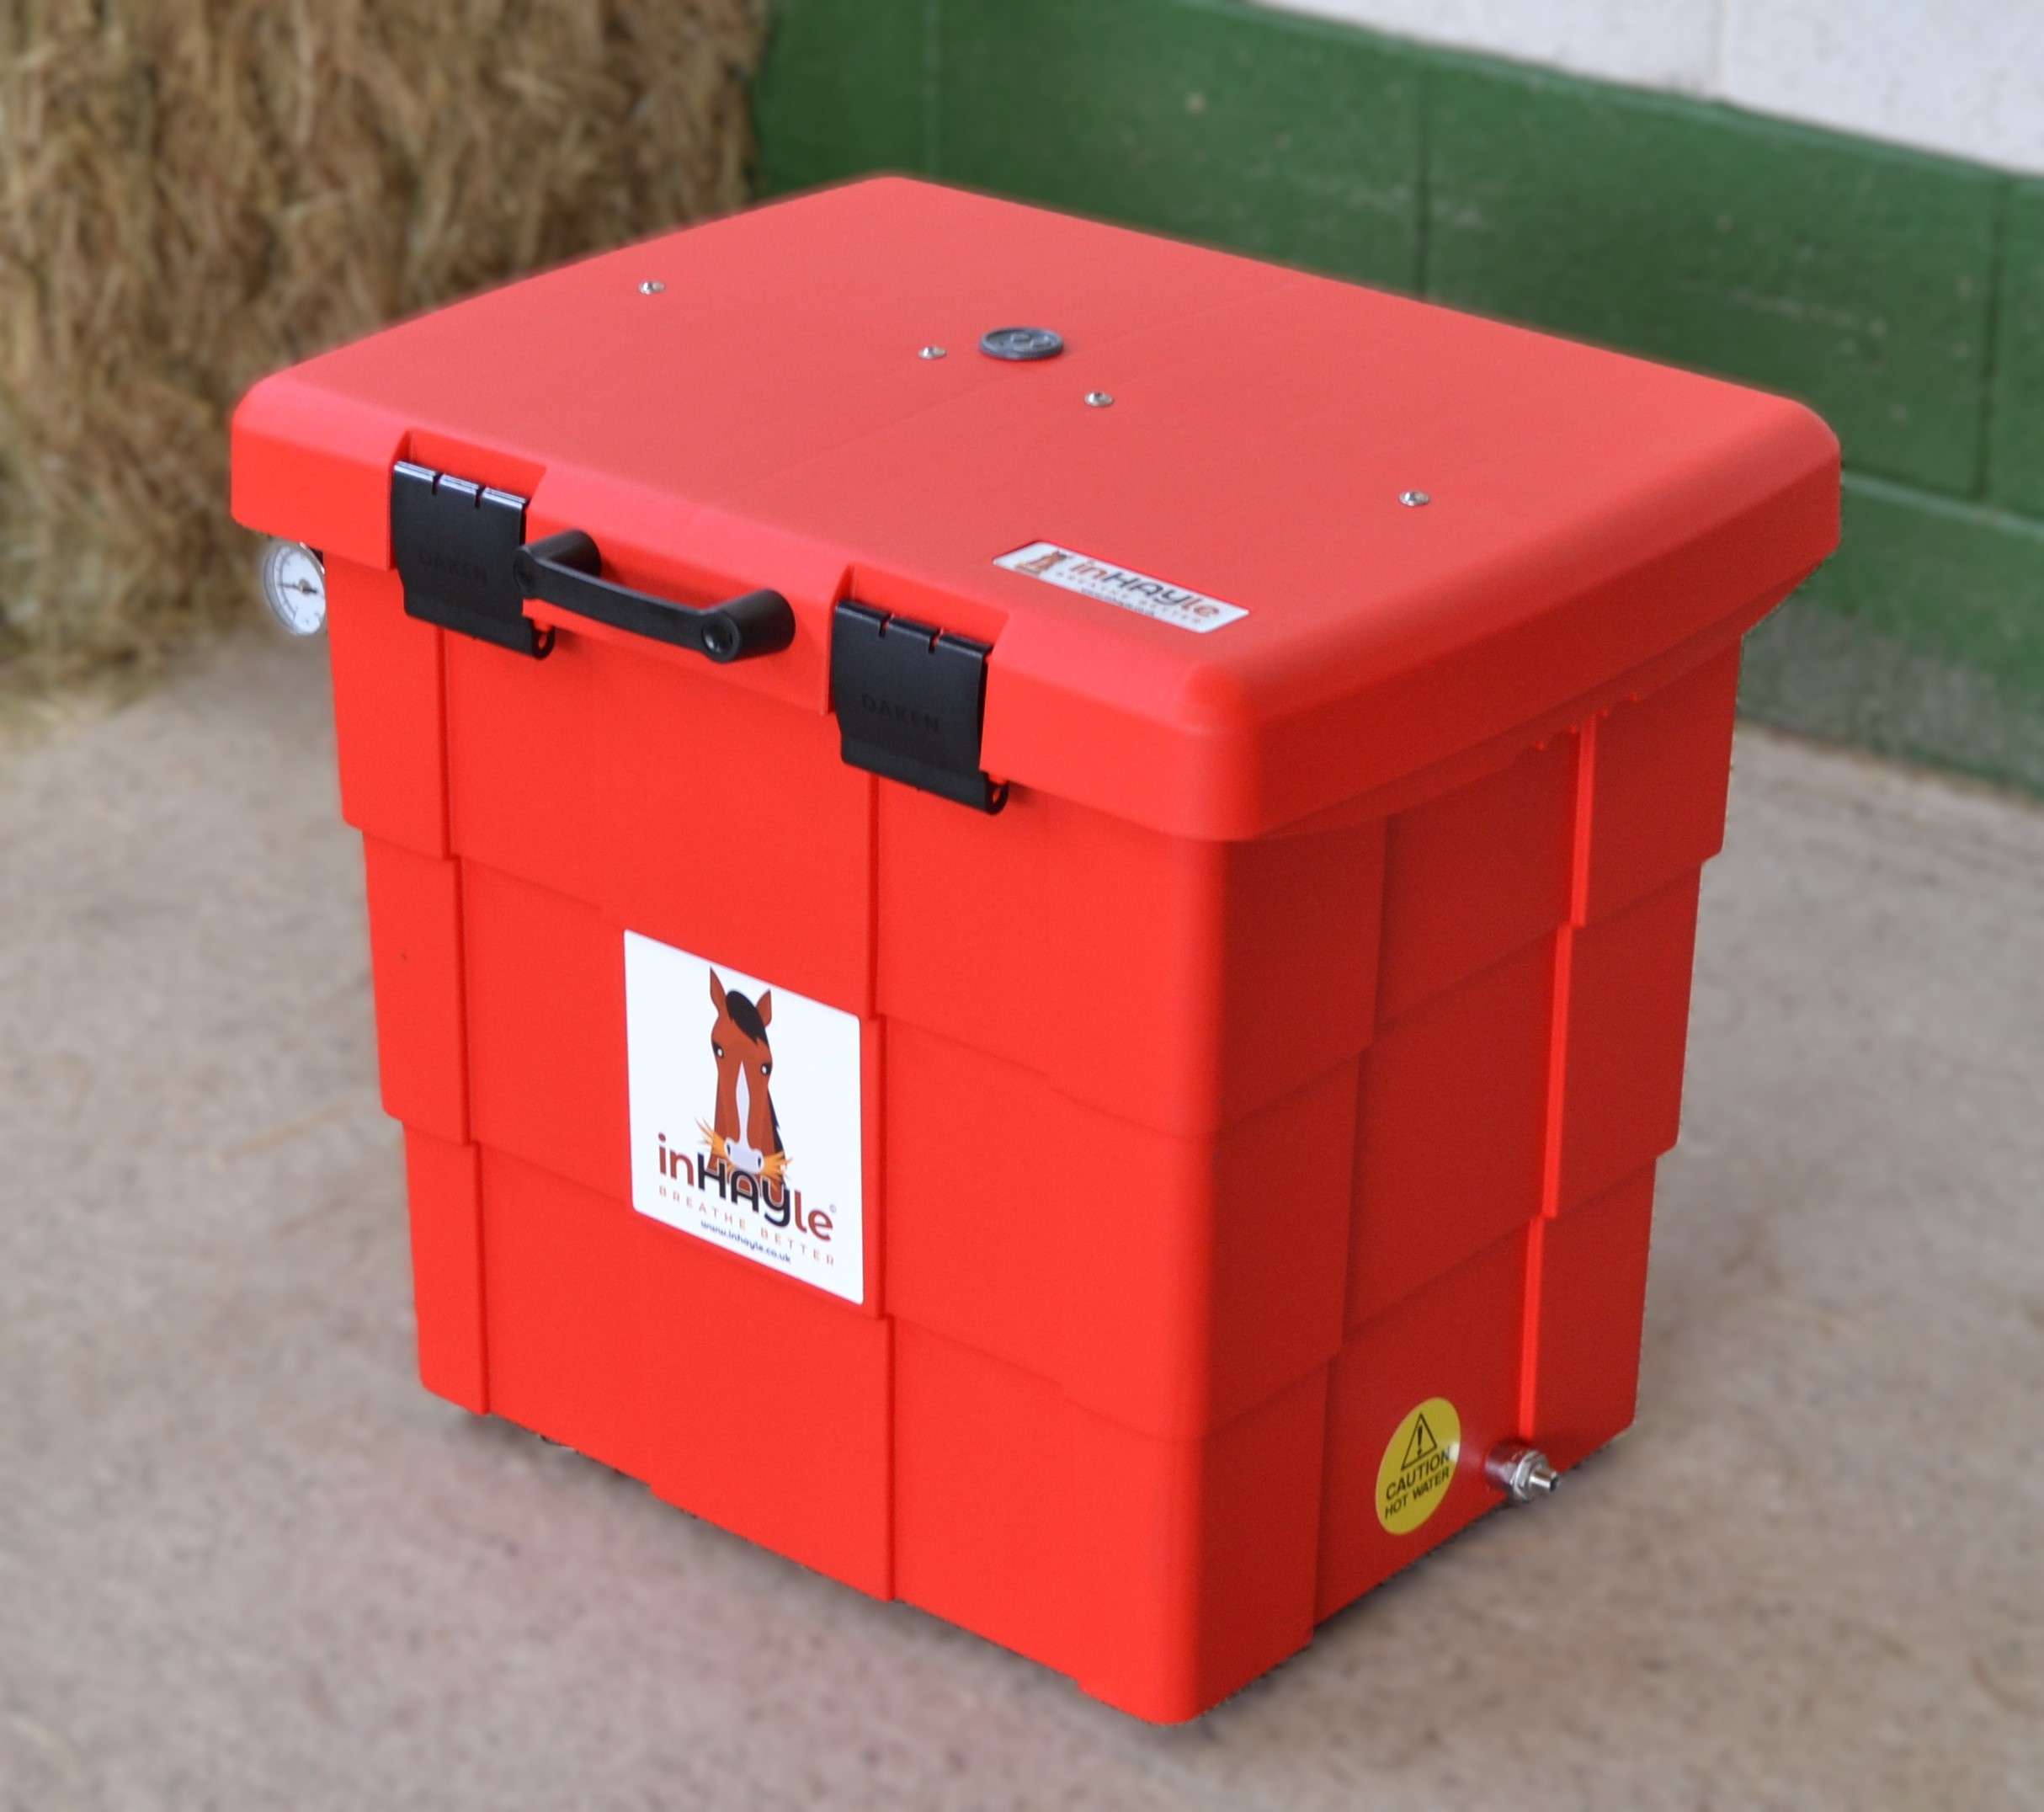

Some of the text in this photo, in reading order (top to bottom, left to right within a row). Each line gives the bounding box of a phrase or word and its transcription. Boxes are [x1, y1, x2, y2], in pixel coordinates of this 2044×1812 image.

[659, 1185, 834, 1266] BREATHE BETTER
[700, 1219, 791, 1263] www.inhayle.co.uk
[1384, 1466, 1450, 1520] HOT WATER
[1386, 1445, 1450, 1500] CAUTION
